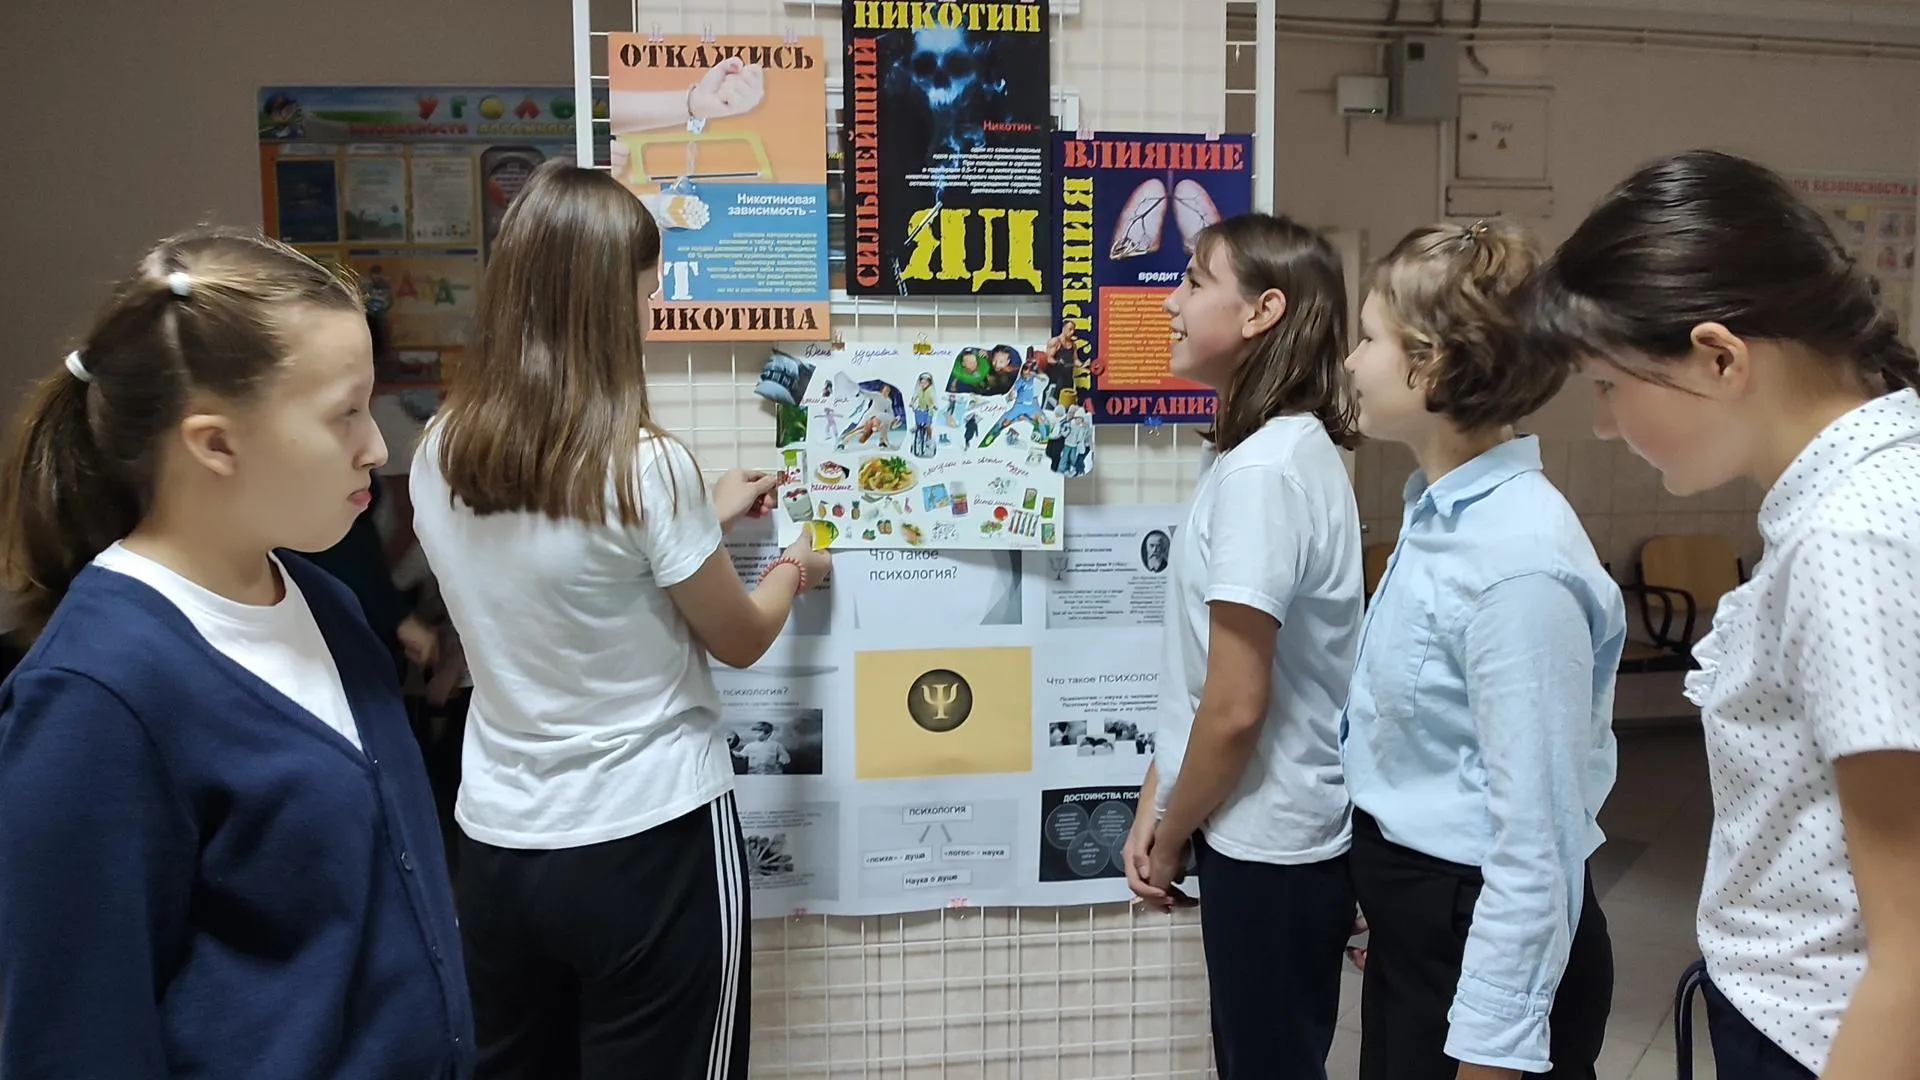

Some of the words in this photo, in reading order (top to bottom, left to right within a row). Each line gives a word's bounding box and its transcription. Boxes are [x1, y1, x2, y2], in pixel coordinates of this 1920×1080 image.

[853, 1, 1041, 32] НИКОТИН
[620, 43, 814, 69] ОТКАЖИСЬ
[417, 95, 576, 120] УГОЛО
[983, 120, 1032, 132] Никотин
[848, 37, 880, 287] СИЛЬНЕЙШИЙ
[1063, 140, 1244, 170] ВЛИЯНИЕ
[737, 193, 816, 205] Никотиновая
[727, 206, 806, 216] зависимость
[900, 208, 1042, 293] ЯД
[663, 261, 699, 300] Т
[1138, 271, 1179, 283] вредит
[652, 307, 818, 331] ИКОТИНА
[1083, 397, 1096, 415] А
[1106, 396, 1219, 416] ОРГАНИЗ
[869, 548, 894, 561] Что
[901, 549, 939, 560] такое
[869, 565, 958, 581] психология?
[1046, 677, 1065, 685] Что
[1068, 676, 1096, 684] такое
[1098, 673, 1159, 683] ПСИХОЛОГ
[1063, 792, 1121, 803] ДОСТОИНСТВА
[1122, 791, 1140, 800] ПСИ
[982, 849, 1005, 858] наука
[905, 876, 928, 886] Наука
